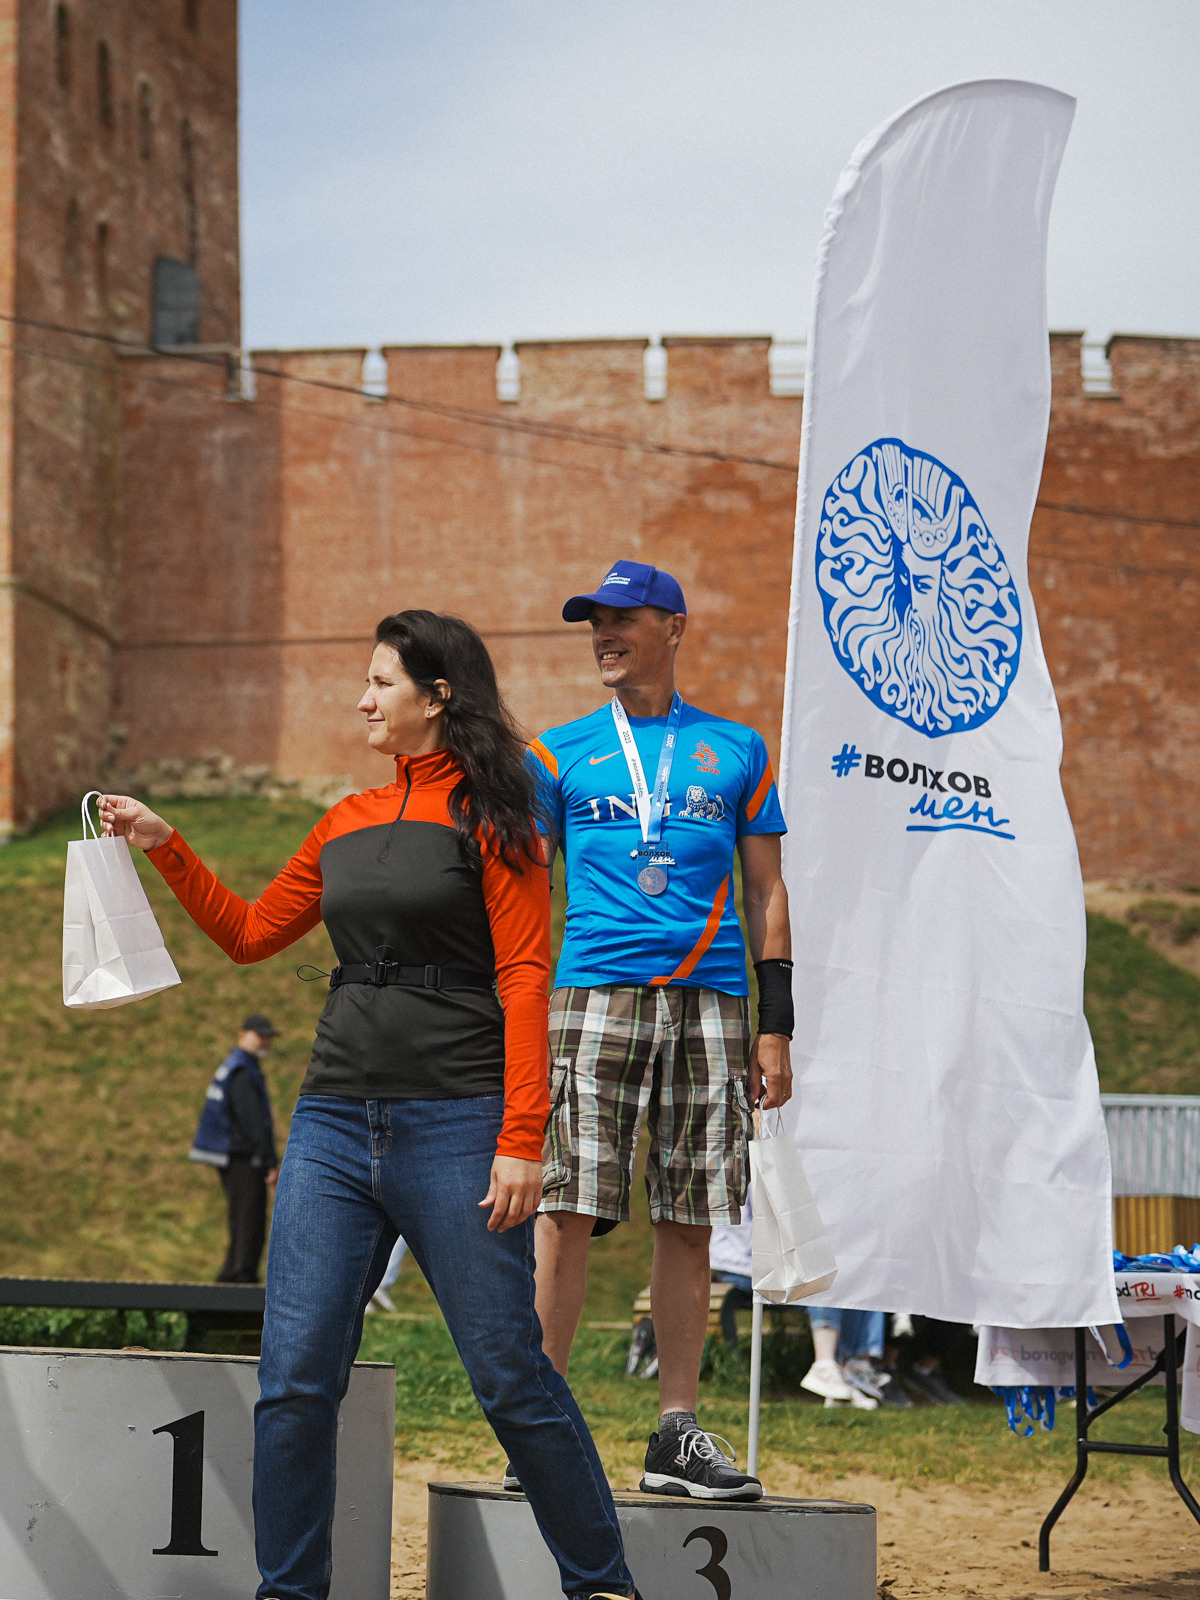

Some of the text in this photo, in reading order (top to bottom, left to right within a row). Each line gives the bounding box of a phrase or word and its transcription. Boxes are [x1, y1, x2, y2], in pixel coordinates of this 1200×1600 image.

[697, 765, 720, 775] KNVB
[831, 743, 992, 798] #ВОЛХОВ
[909, 793, 1010, 827] мен
[152, 1410, 219, 1557] 1
[682, 1525, 732, 1600] 3
